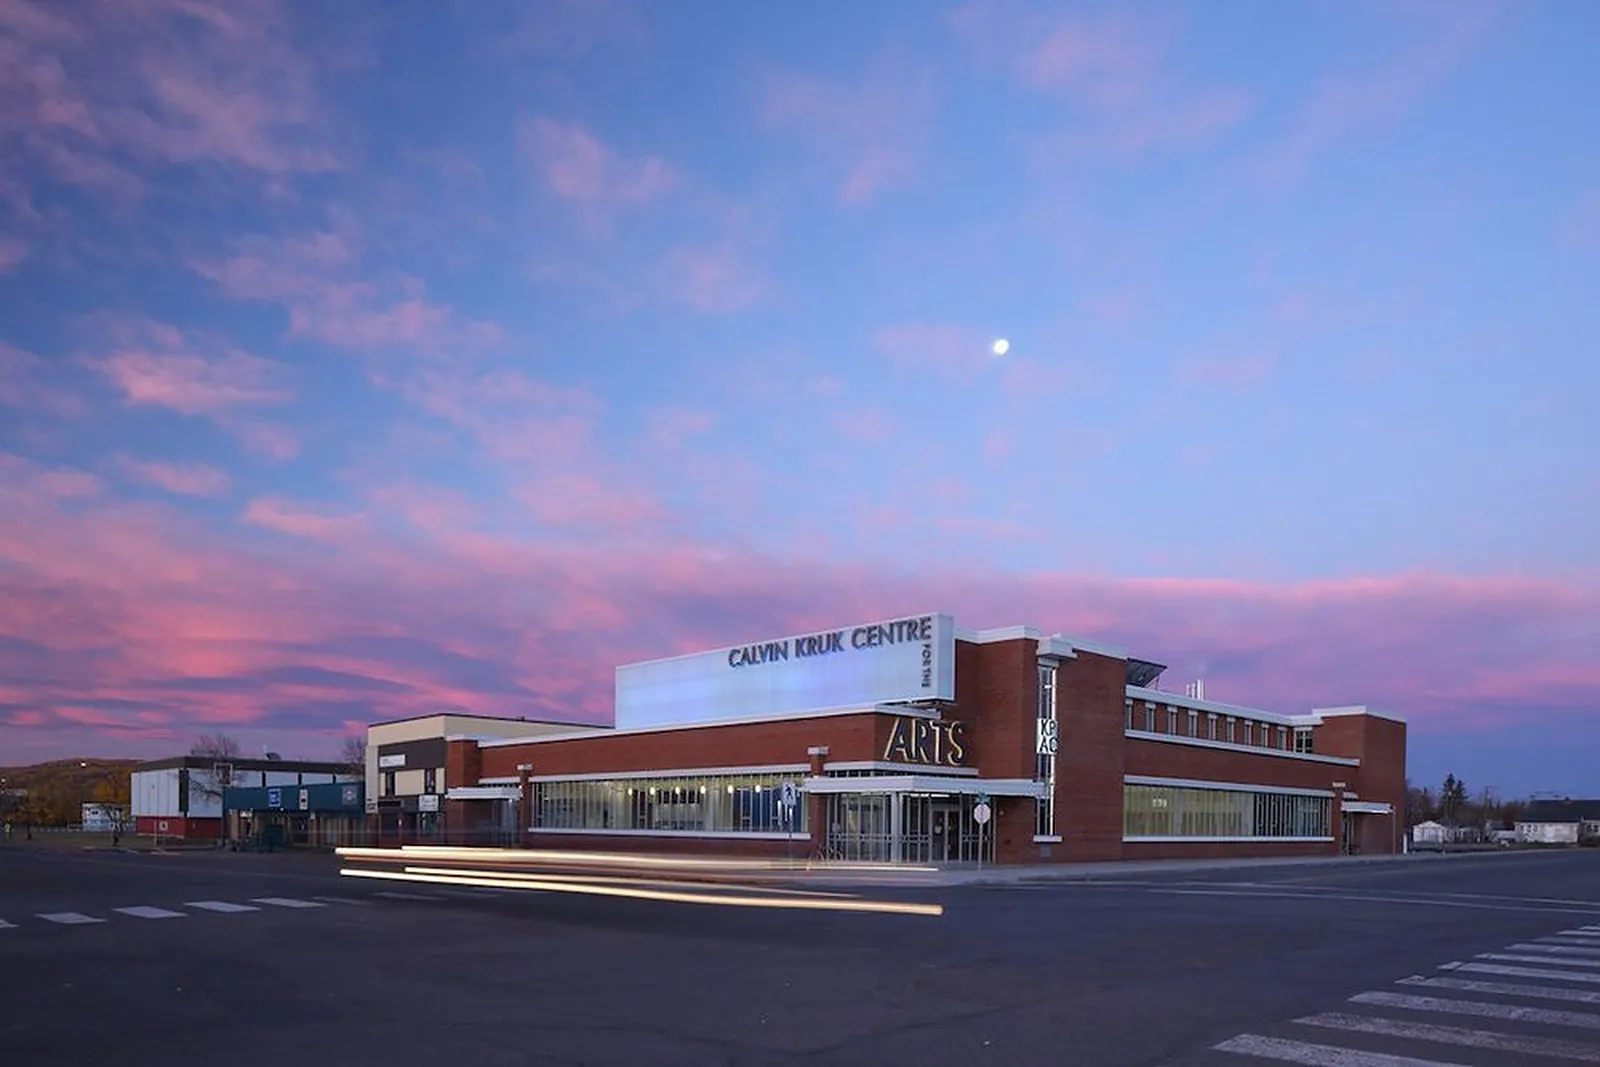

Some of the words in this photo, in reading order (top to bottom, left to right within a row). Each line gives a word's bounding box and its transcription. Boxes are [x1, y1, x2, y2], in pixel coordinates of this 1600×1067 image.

[728, 641, 789, 668] CALVIN
[795, 632, 844, 658] KRUK
[852, 617, 932, 648] CENTRE
[884, 717, 966, 766] ARTS
